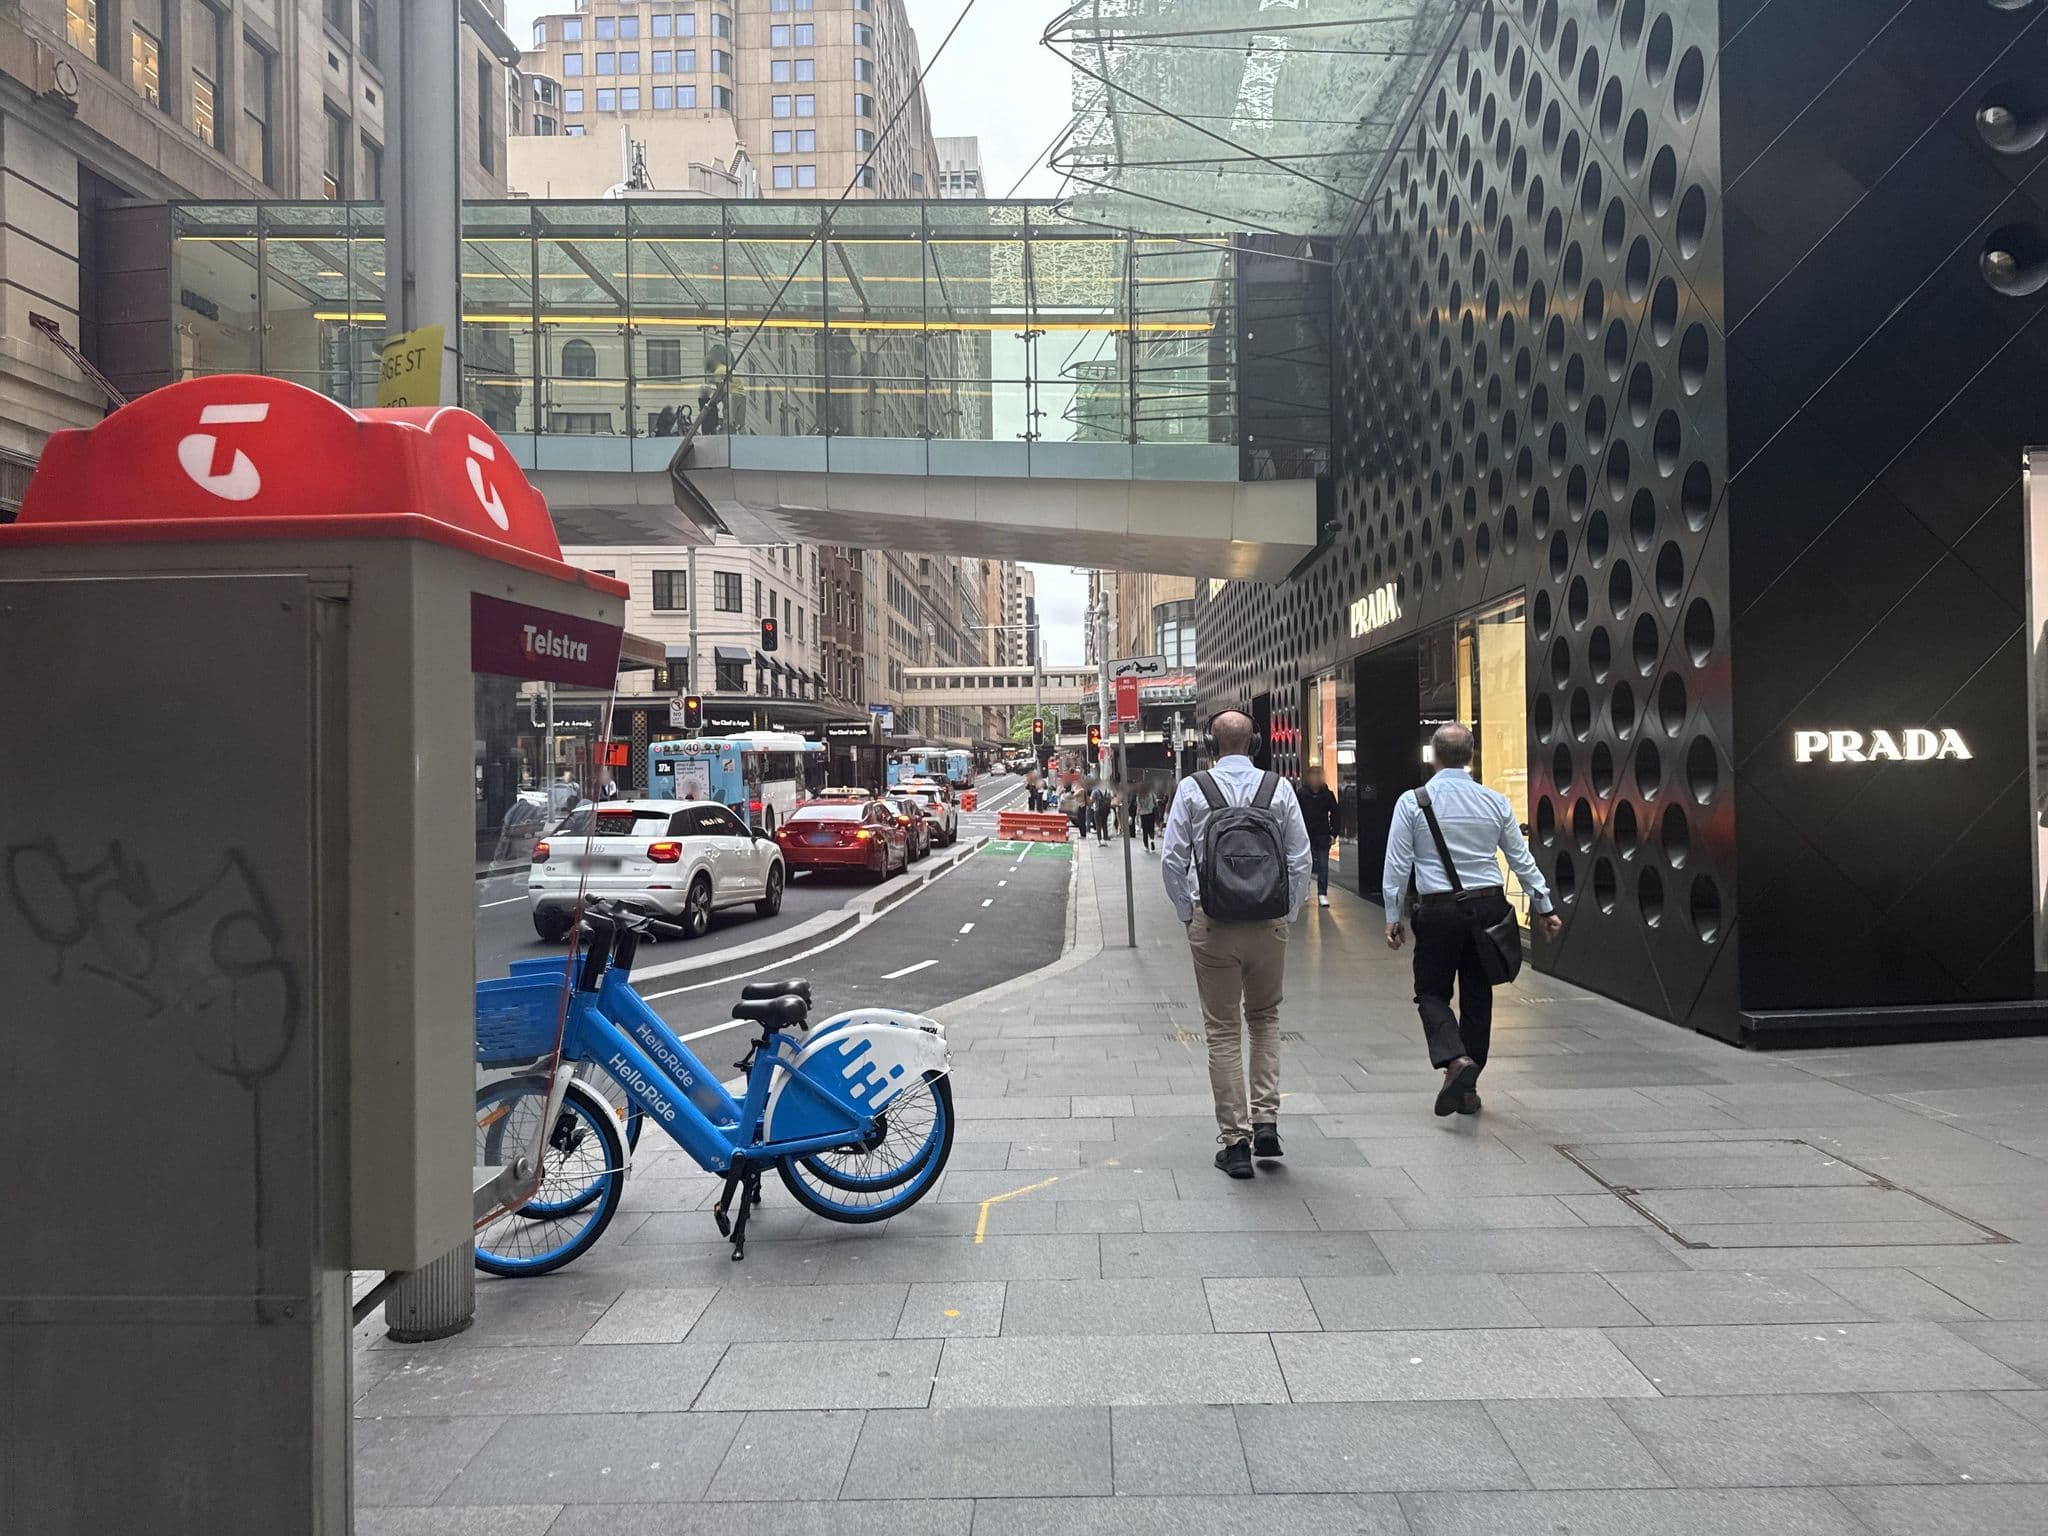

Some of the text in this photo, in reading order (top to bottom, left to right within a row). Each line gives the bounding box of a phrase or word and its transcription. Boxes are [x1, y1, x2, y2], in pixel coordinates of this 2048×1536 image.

[405, 347, 427, 372] ST
[1350, 582, 1402, 639] PRADA
[523, 624, 588, 662] Telstra
[685, 743, 699, 752] 40
[1794, 728, 1974, 762] PRADA
[636, 1023, 693, 1086] HelloRide
[608, 1052, 676, 1122] HelloRide
